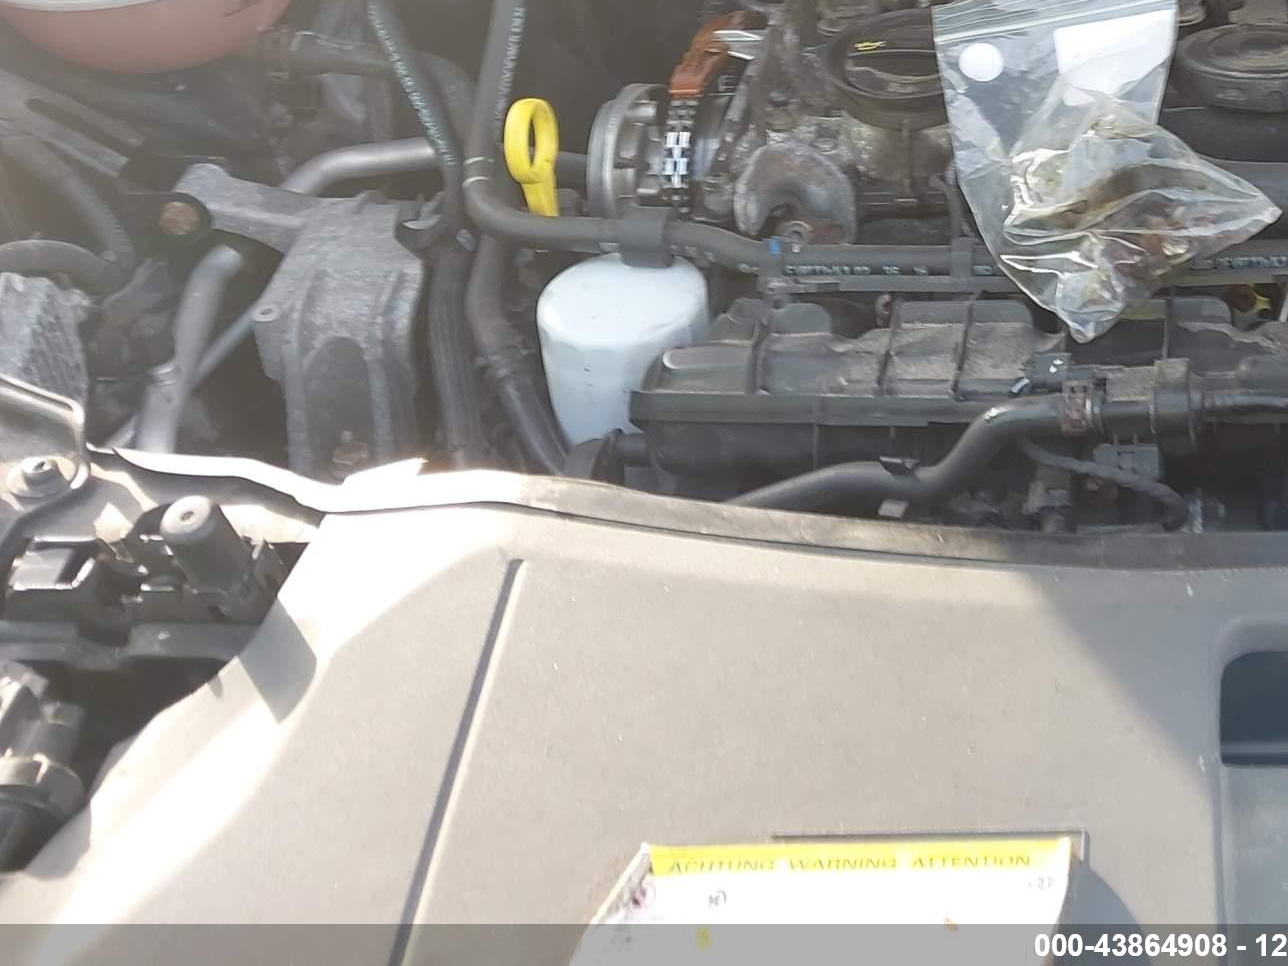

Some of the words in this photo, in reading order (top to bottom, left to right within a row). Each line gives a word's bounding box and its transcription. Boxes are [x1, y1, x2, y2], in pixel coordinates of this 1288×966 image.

[667, 857, 775, 874] ACHTUNG
[788, 857, 898, 872] WARNING
[911, 854, 1031, 869] ATTENTION
